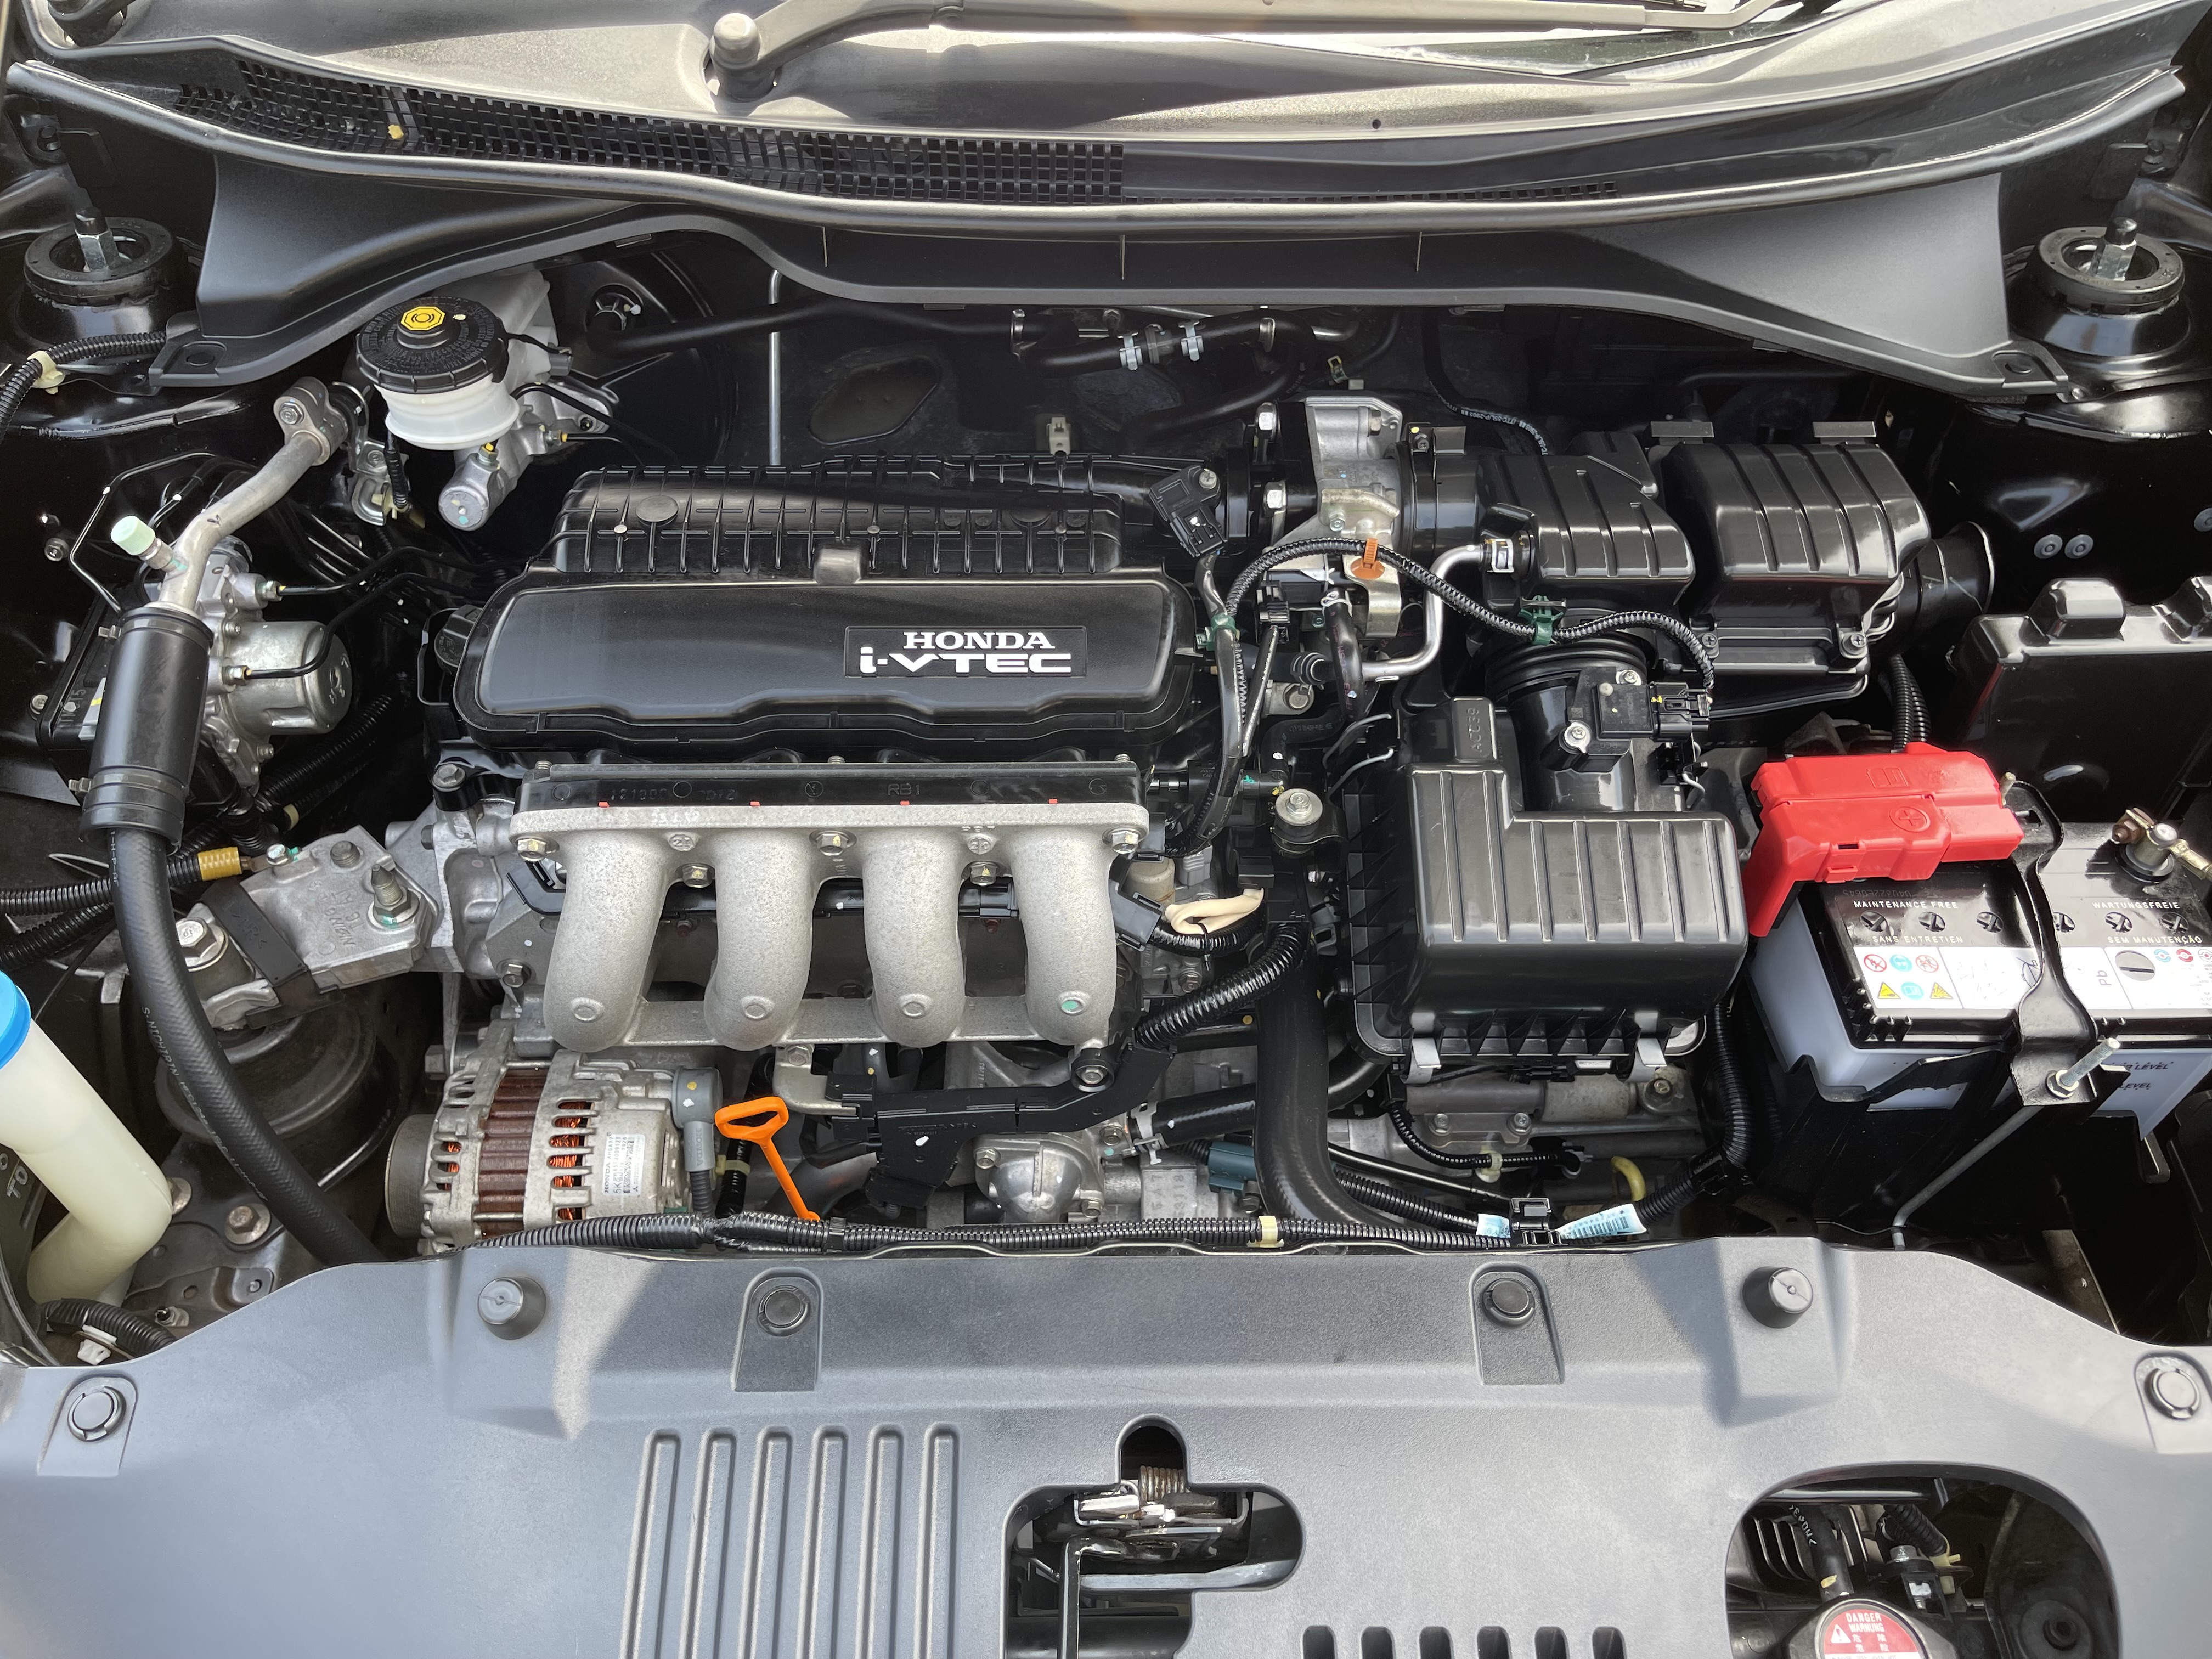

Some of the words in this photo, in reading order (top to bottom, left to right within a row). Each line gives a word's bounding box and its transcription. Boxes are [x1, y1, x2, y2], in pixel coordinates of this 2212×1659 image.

[903, 631, 1056, 650] HONDA
[860, 646, 1072, 674] i-VTEC
[2133, 935, 2202, 944] MANUTENÇÃO
[2097, 970, 2112, 986] Pb
[1846, 1612, 1882, 1622] DANGER
[1848, 1623, 1884, 1633] WARNUNG
